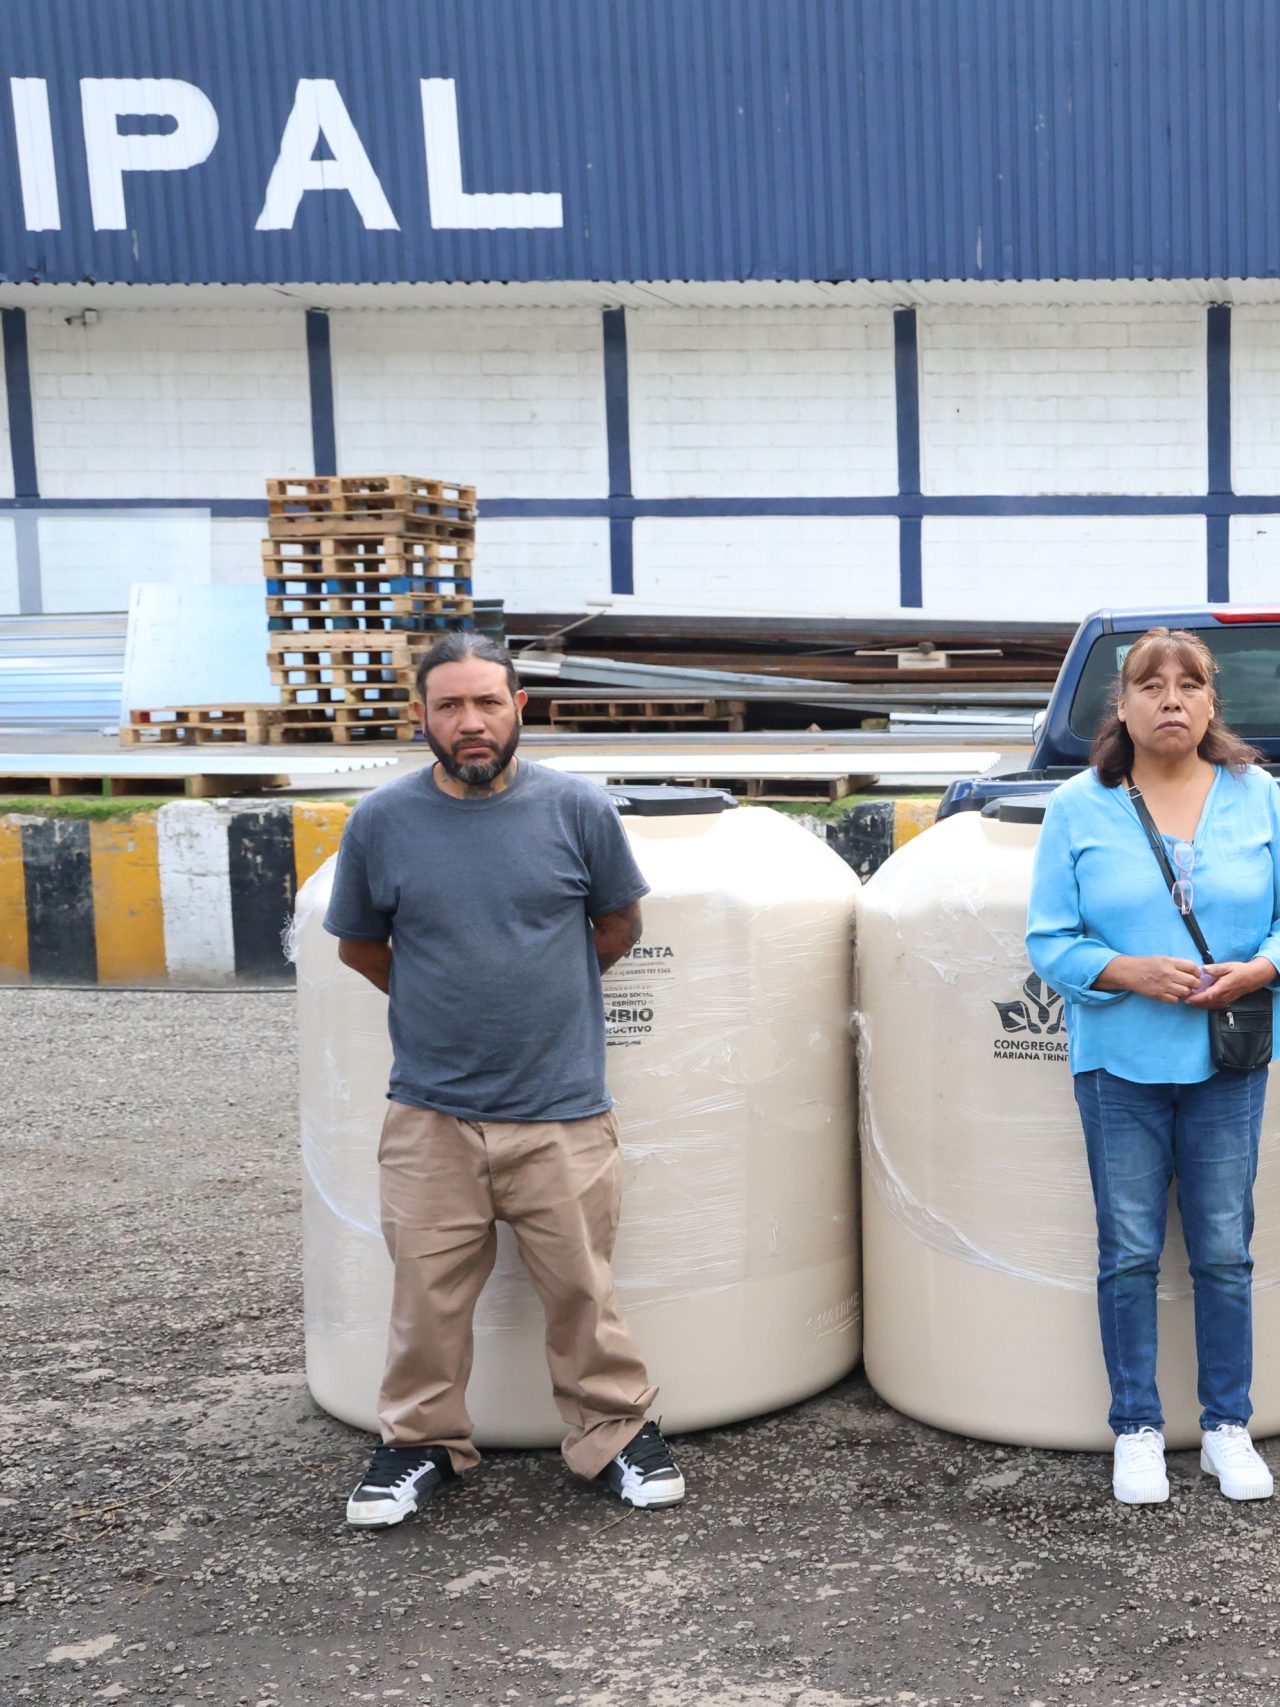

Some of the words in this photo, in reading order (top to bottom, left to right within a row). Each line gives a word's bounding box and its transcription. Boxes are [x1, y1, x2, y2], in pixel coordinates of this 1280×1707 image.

[10, 78, 563, 231] IPAL
[993, 1051, 1040, 1061] MARIANA
[1042, 1052, 1069, 1062] TRINI
